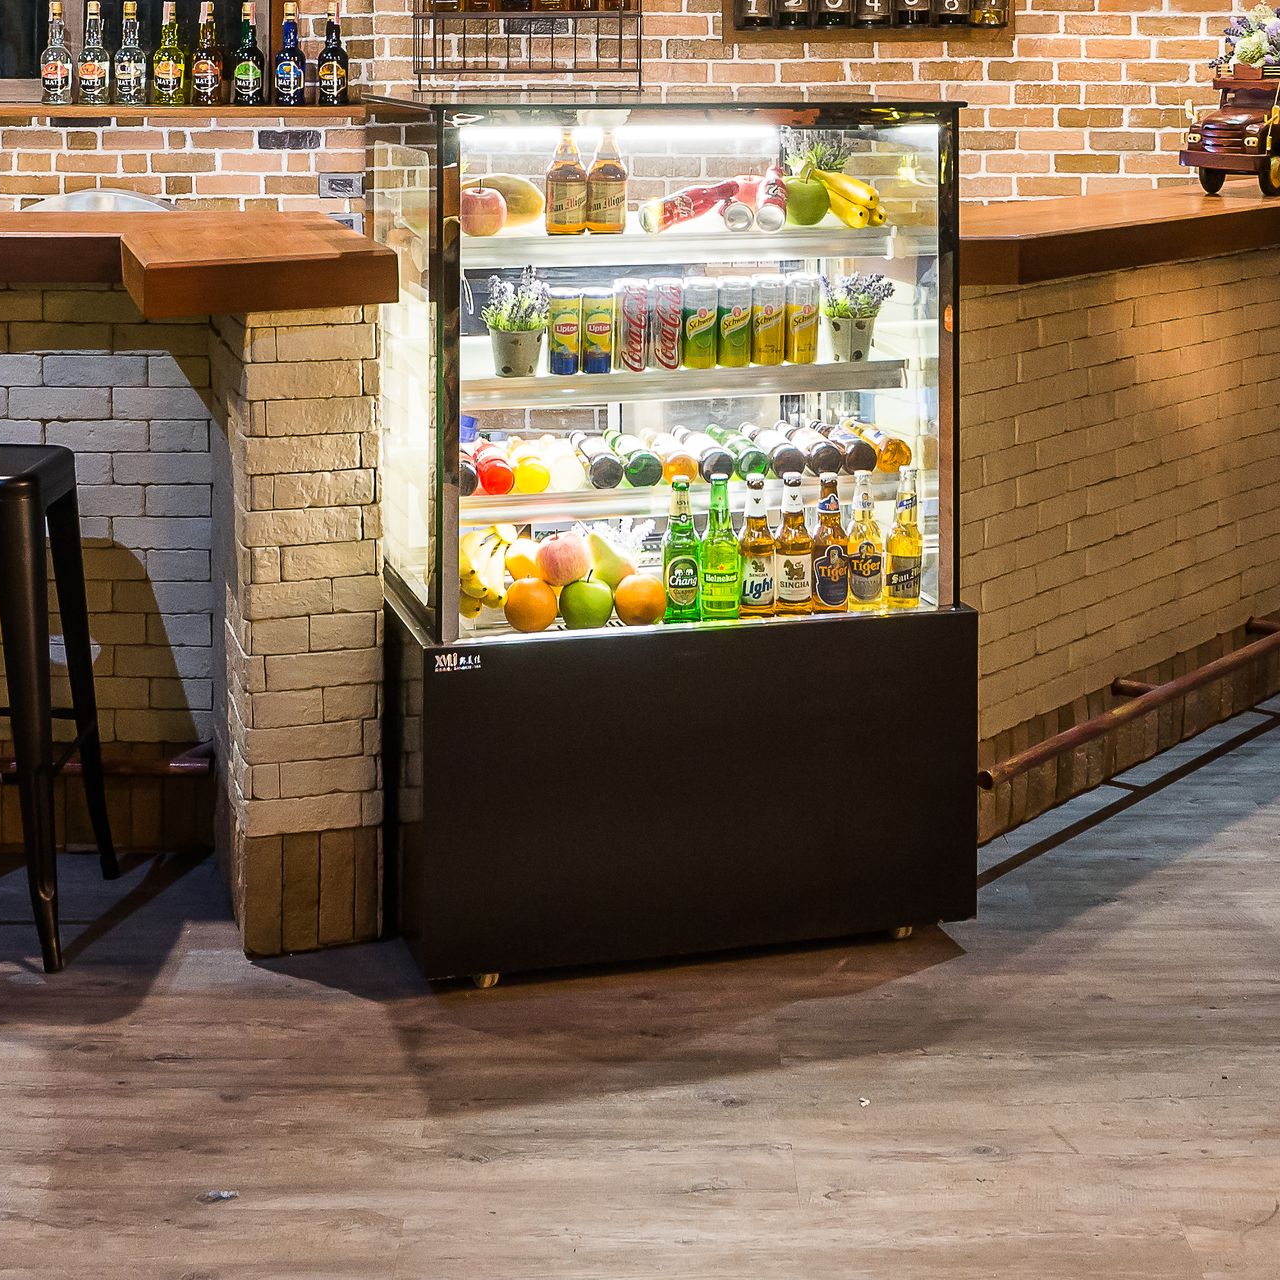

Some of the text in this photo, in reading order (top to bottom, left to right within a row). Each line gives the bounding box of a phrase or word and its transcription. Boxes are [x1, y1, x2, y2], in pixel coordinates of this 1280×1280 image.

[556, 324, 578, 334] Lipton
[588, 323, 610, 333] Lipton
[818, 564, 847, 583] Tiger
[851, 559, 880, 577] Tiger
[669, 574, 698, 587] Chang
[706, 572, 737, 583] Heineken
[780, 581, 810, 589] SINGHA
